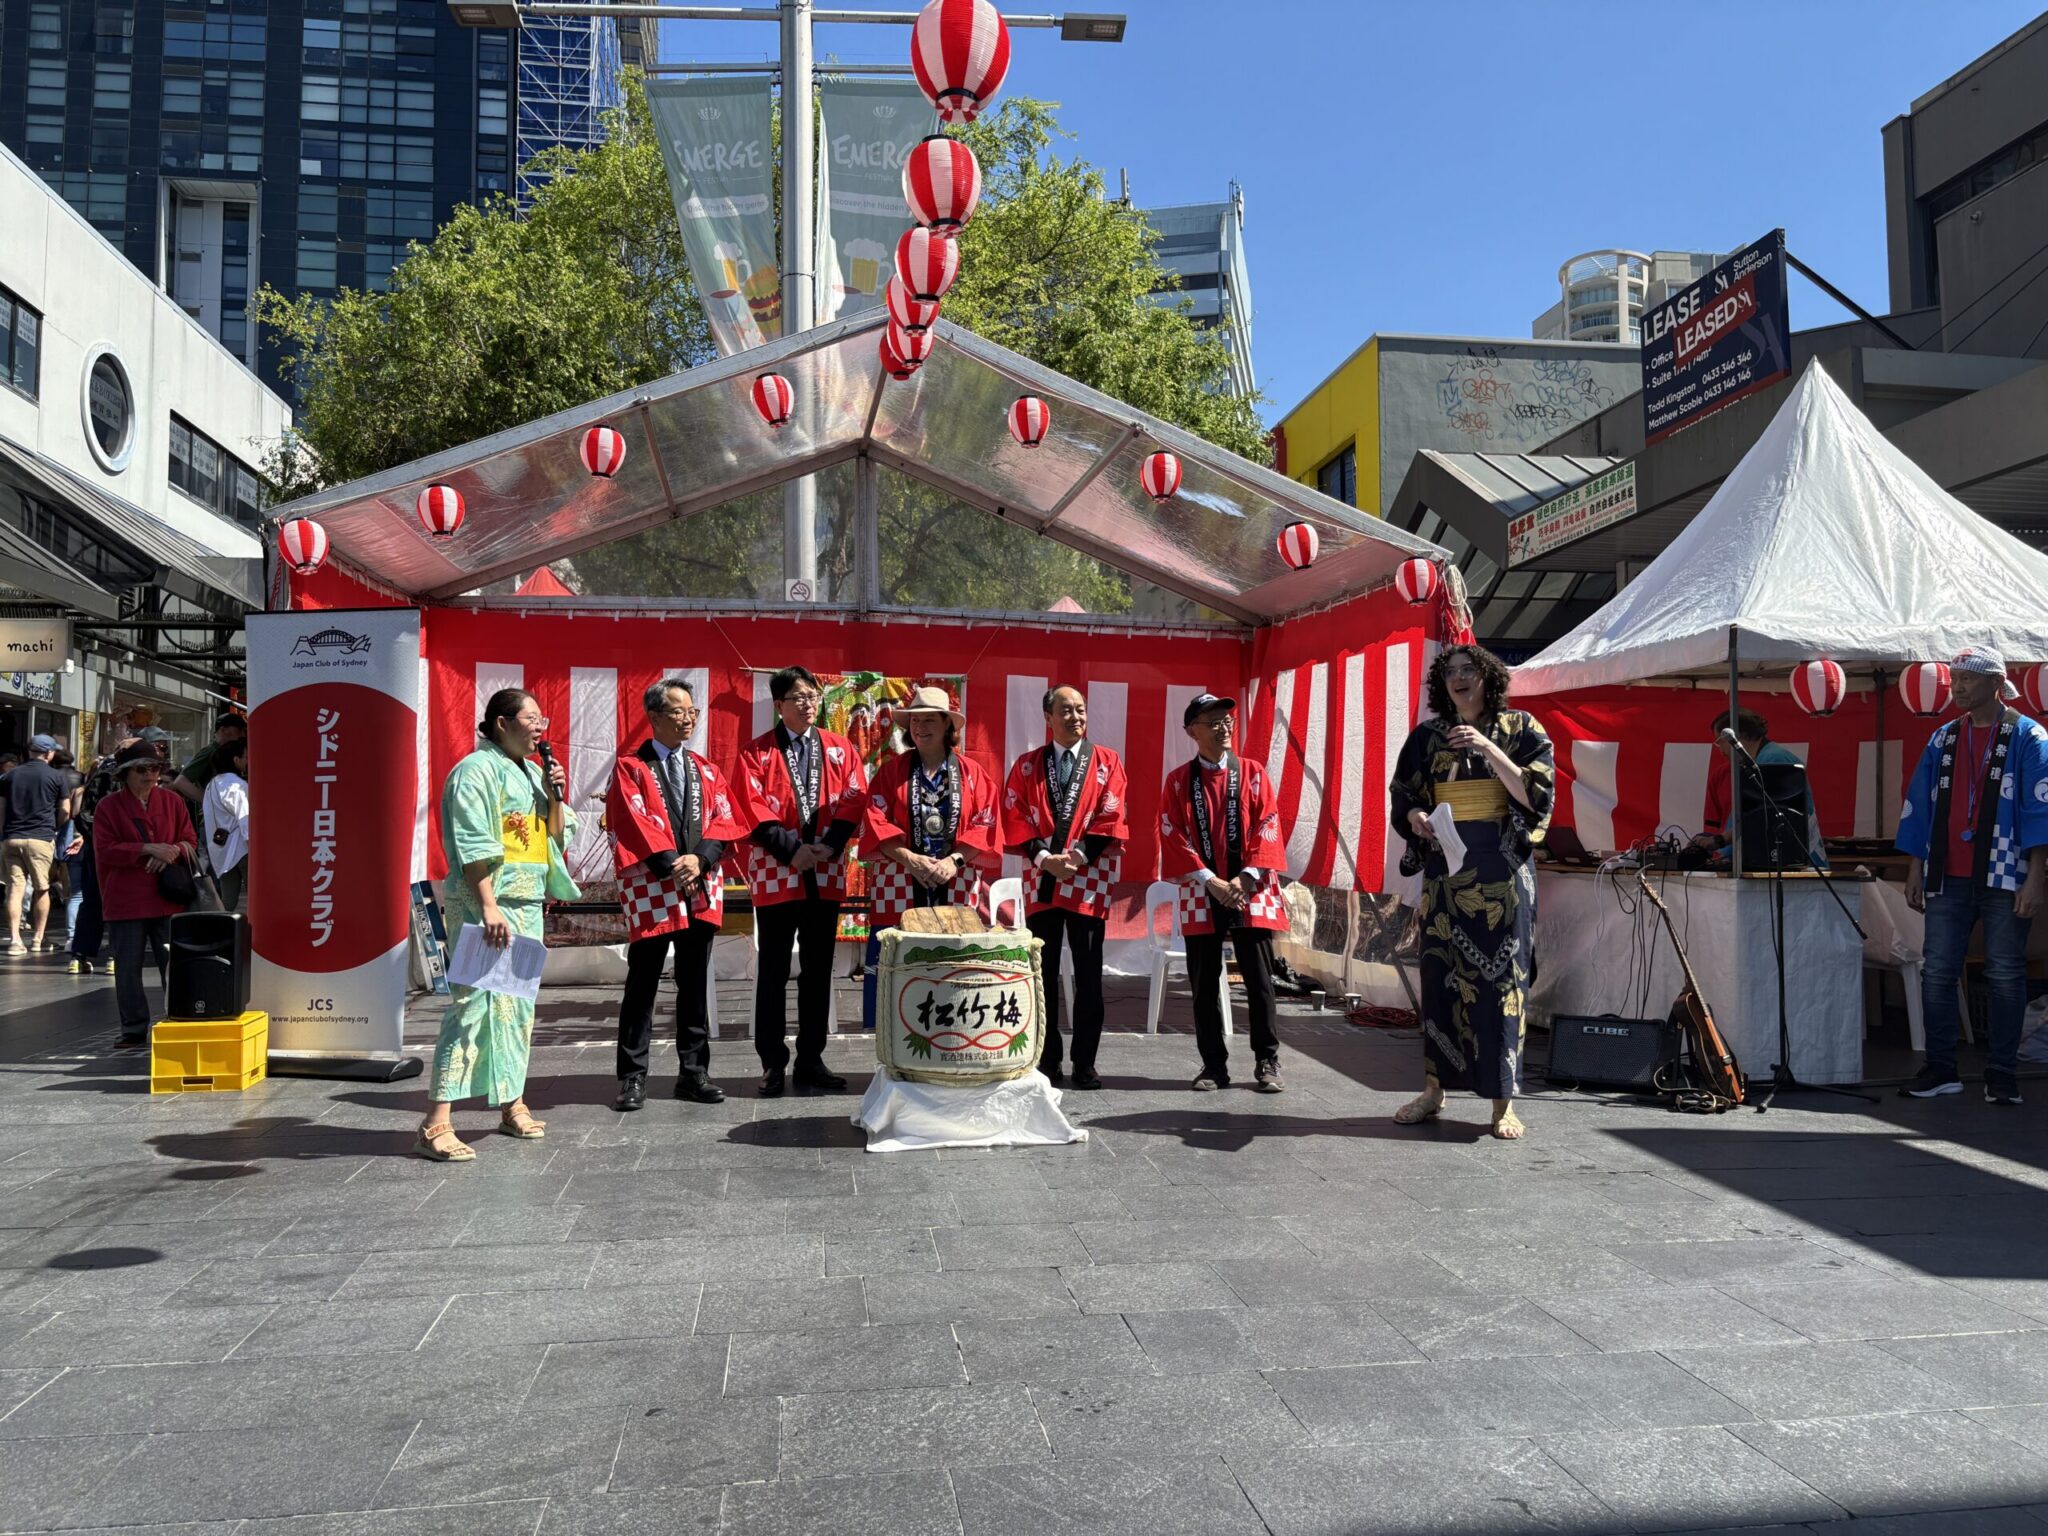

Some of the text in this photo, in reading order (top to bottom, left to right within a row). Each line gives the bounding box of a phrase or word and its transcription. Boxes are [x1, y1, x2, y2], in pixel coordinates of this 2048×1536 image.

[832, 134, 913, 170] EMERG
[1733, 250, 1759, 272] Sutton
[1643, 286, 1701, 346] LEASE
[1676, 296, 1738, 358] LEASED
[1651, 350, 1674, 369] Office
[1648, 397, 1665, 414] Todd
[1666, 383, 1697, 404] Kingston
[1702, 366, 1720, 385] 0433
[1652, 371, 1672, 388] Suite
[1648, 409, 1678, 430] Matthew
[1703, 382, 1722, 401] 0433
[1723, 376, 1737, 391] 146
[1737, 367, 1752, 384] 146
[7, 639, 53, 652] machi
[292, 661, 314, 669] Japan
[341, 659, 368, 667] Sydney
[26, 681, 54, 700] Station
[310, 707, 341, 948] シドニー日本クラブ
[1228, 800, 1237, 841] 日本クラブ
[307, 998, 334, 1011] JCS
[916, 990, 1022, 1031] 松竹梅
[271, 1015, 369, 1024] www.japanclubofsydney.org
[1583, 1026, 1630, 1036] CUBE
